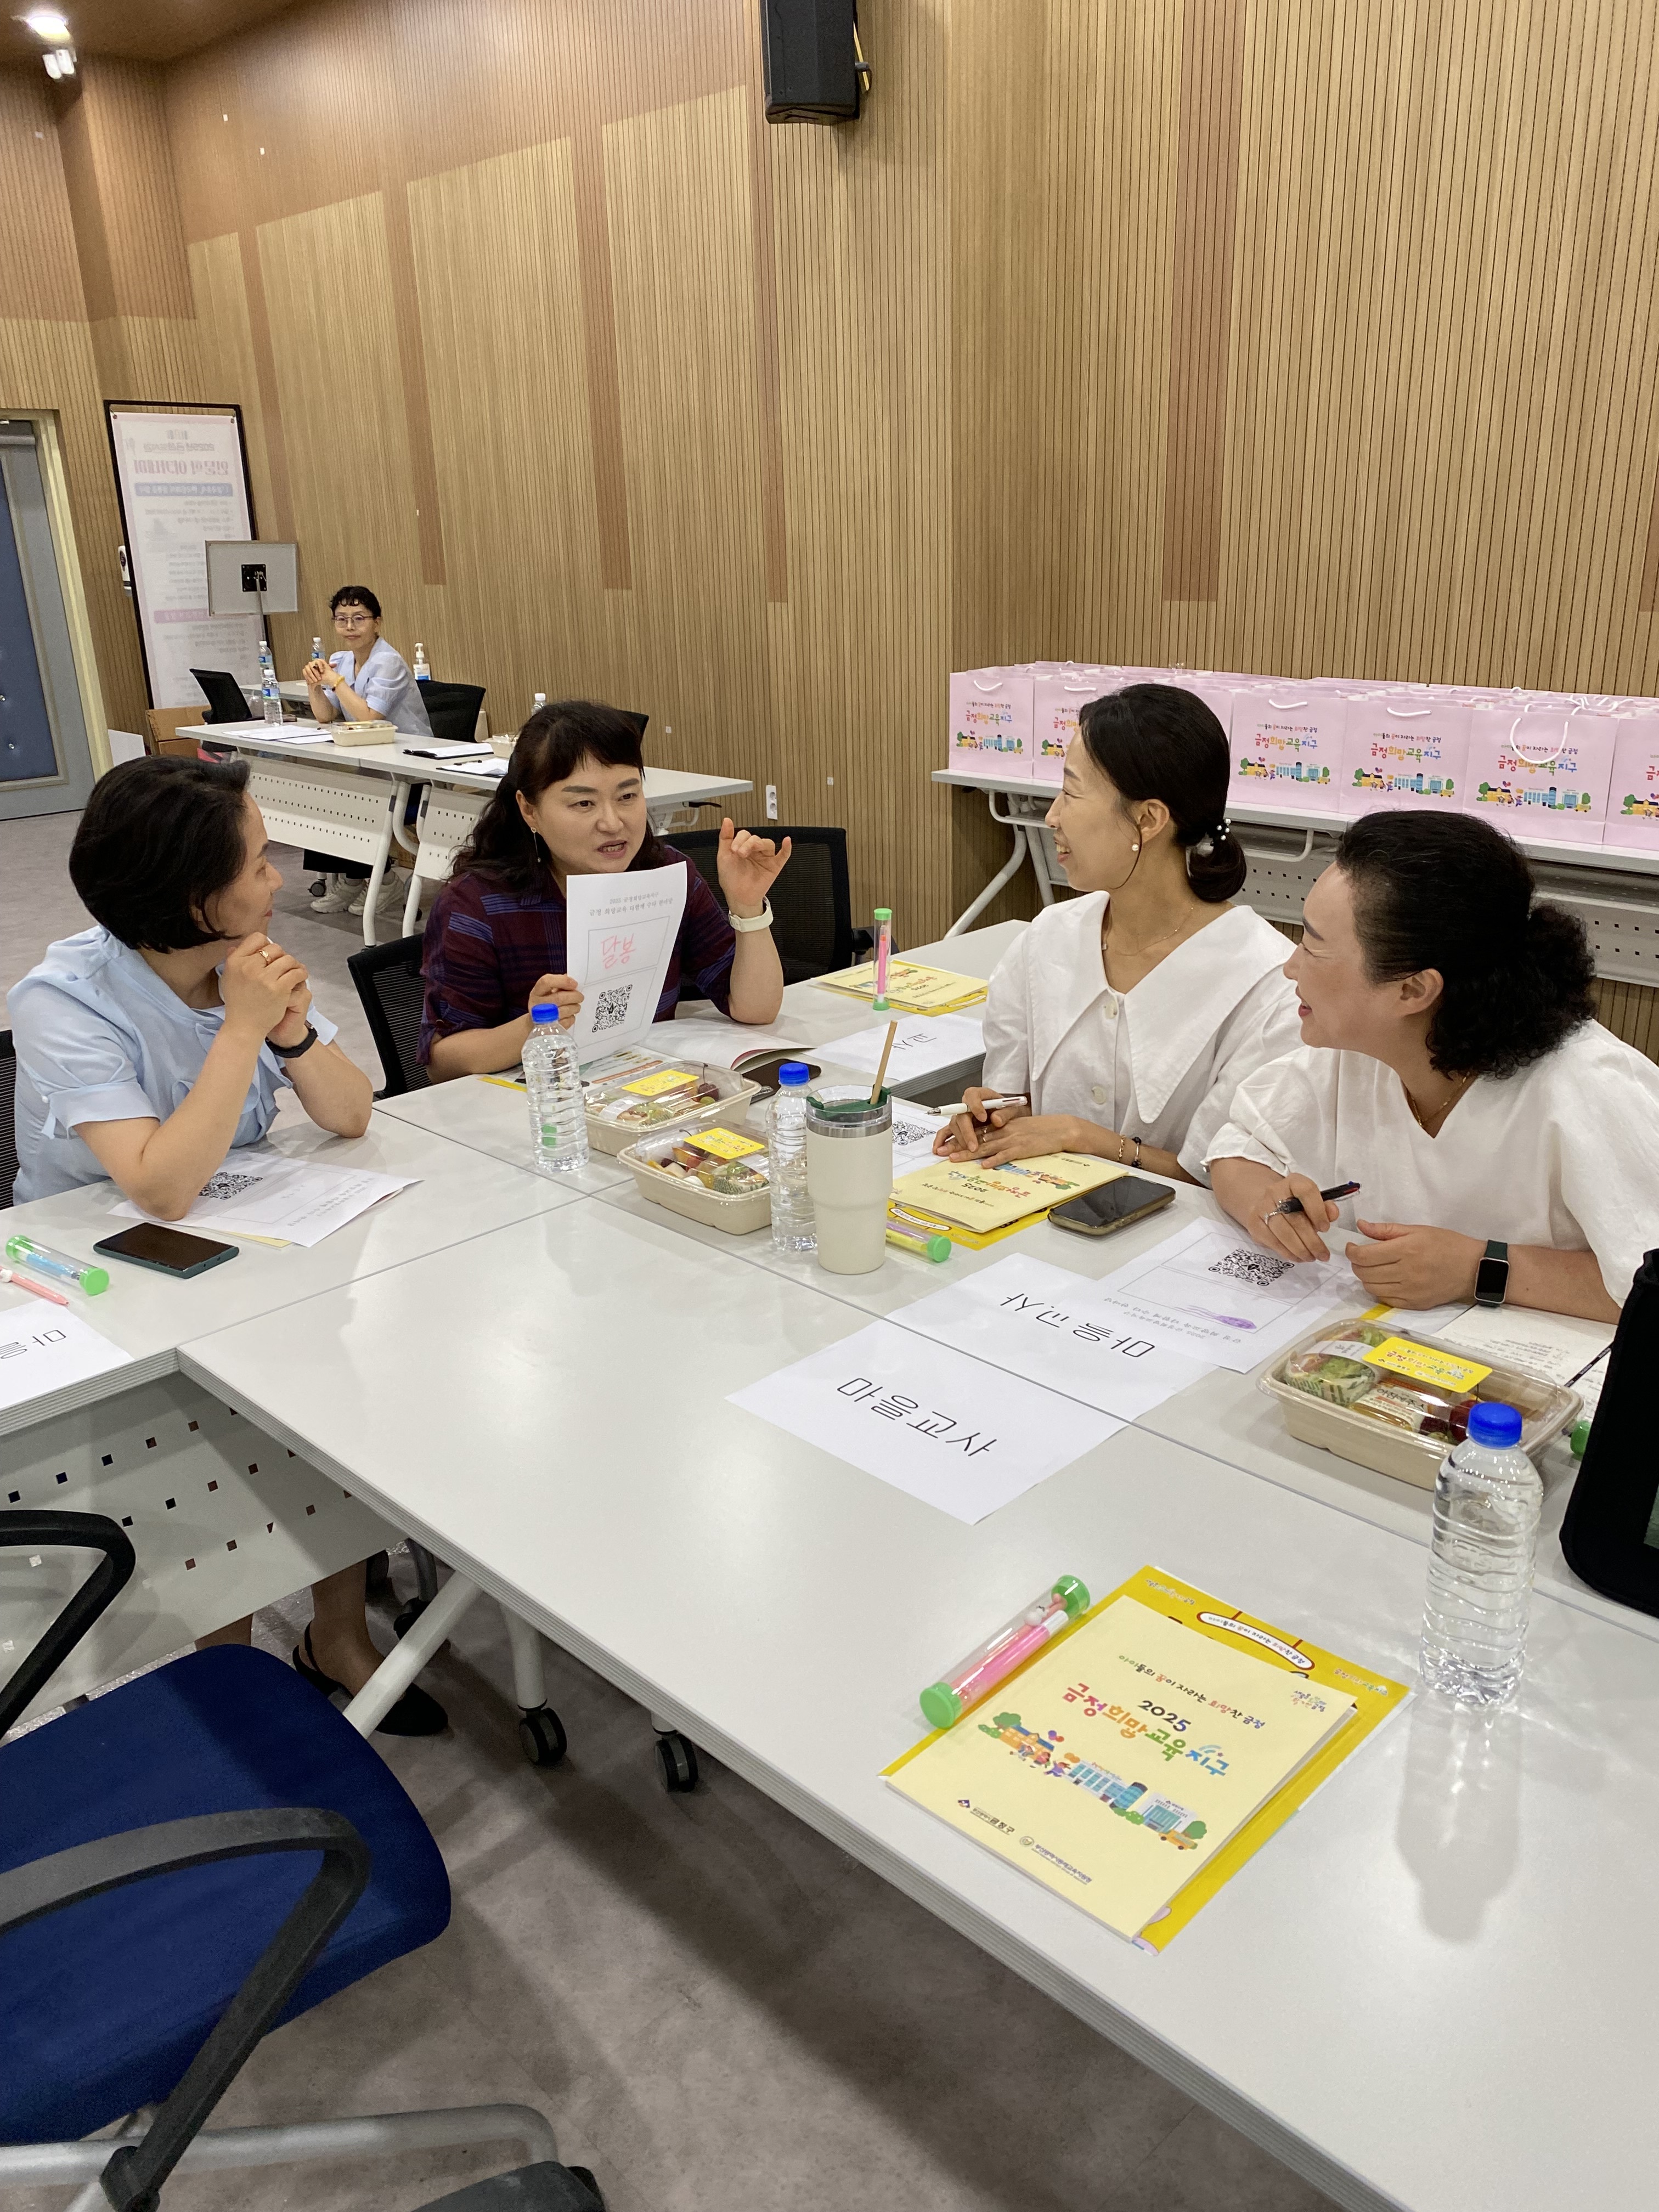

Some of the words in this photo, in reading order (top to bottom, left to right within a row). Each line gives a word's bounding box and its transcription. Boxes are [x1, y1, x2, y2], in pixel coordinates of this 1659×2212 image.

[966, 710, 1012, 726] 금정희망교육지구
[1255, 733, 1318, 752] 금정희망교육지구
[1371, 743, 1441, 763] 금정희망교육지구
[605, 906, 627, 915] 희망교육
[601, 933, 636, 969] 달봉
[961, 1183, 988, 1193] 2025
[1000, 1293, 1156, 1358] 마을교사
[0, 1330, 66, 1359] 마을
[837, 1378, 997, 1457] 마을교사
[1119, 1655, 1155, 1677] 아이들의
[1155, 1673, 1176, 1686] 꿈이
[1176, 1683, 1207, 1703] 자라는
[1208, 1700, 1243, 1719] 희망찬
[1243, 1715, 1266, 1729] 금정
[1062, 1682, 1229, 1777] 금정희망교육지구
[1137, 1700, 1192, 1733] 2025
[990, 1817, 1015, 1833] 금정구
